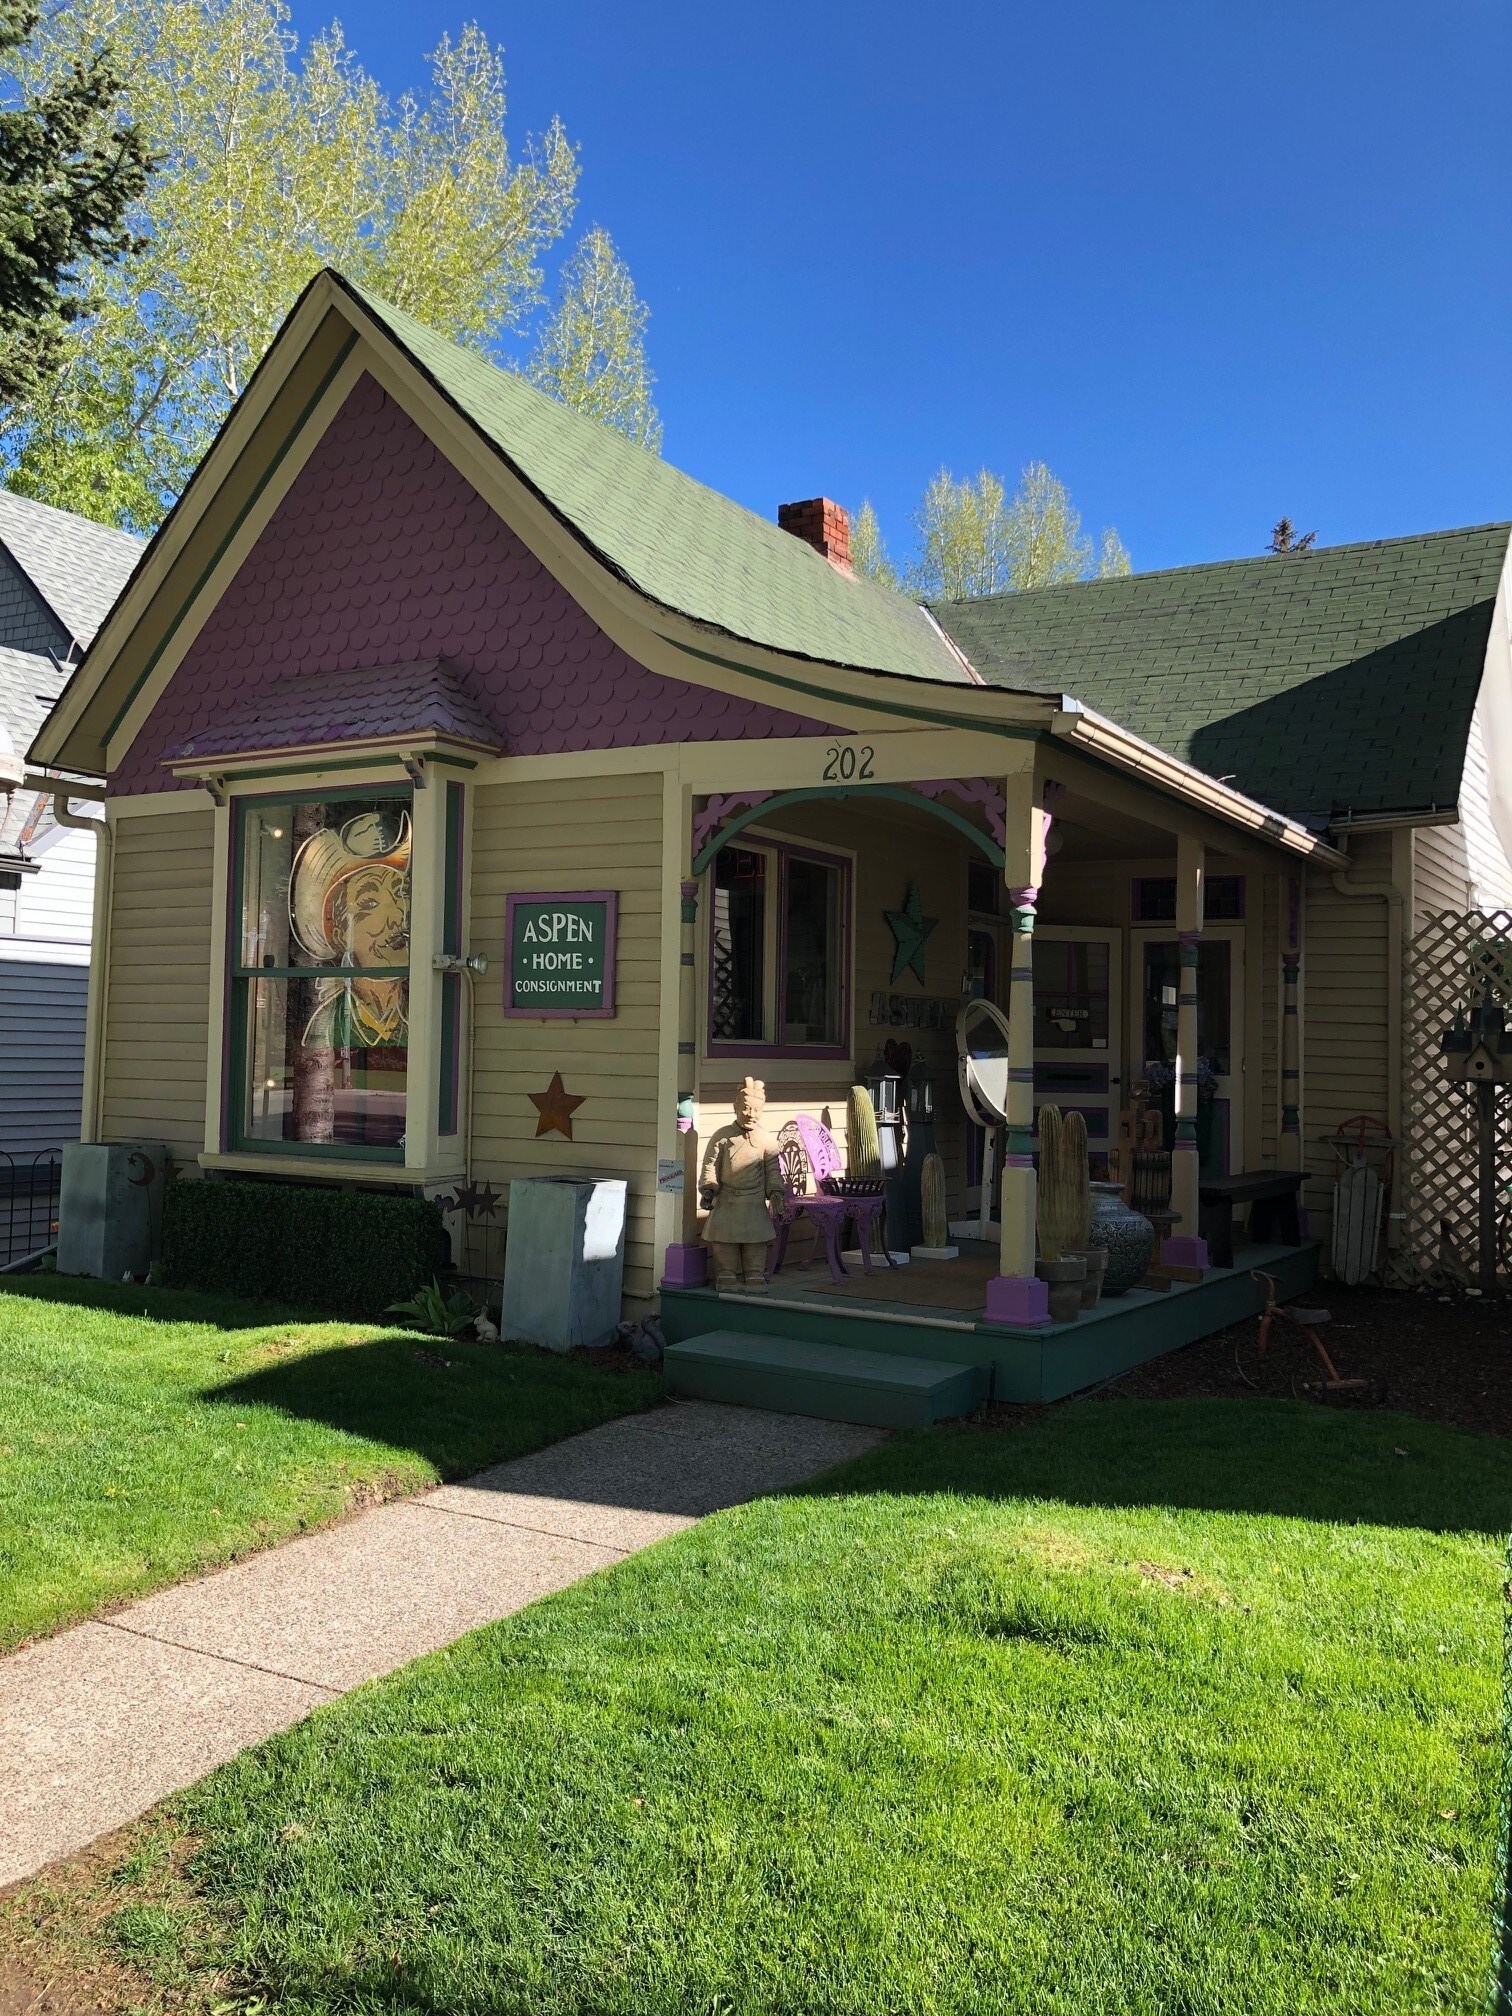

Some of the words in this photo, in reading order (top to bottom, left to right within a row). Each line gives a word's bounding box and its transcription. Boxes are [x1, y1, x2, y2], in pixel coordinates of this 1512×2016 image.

[822, 746, 875, 781] 202
[522, 913, 594, 943] ASPEN
[532, 952, 583, 970] HOME
[515, 980, 602, 993] CONSIGNMENT
[1055, 1008, 1084, 1018] ENTER
